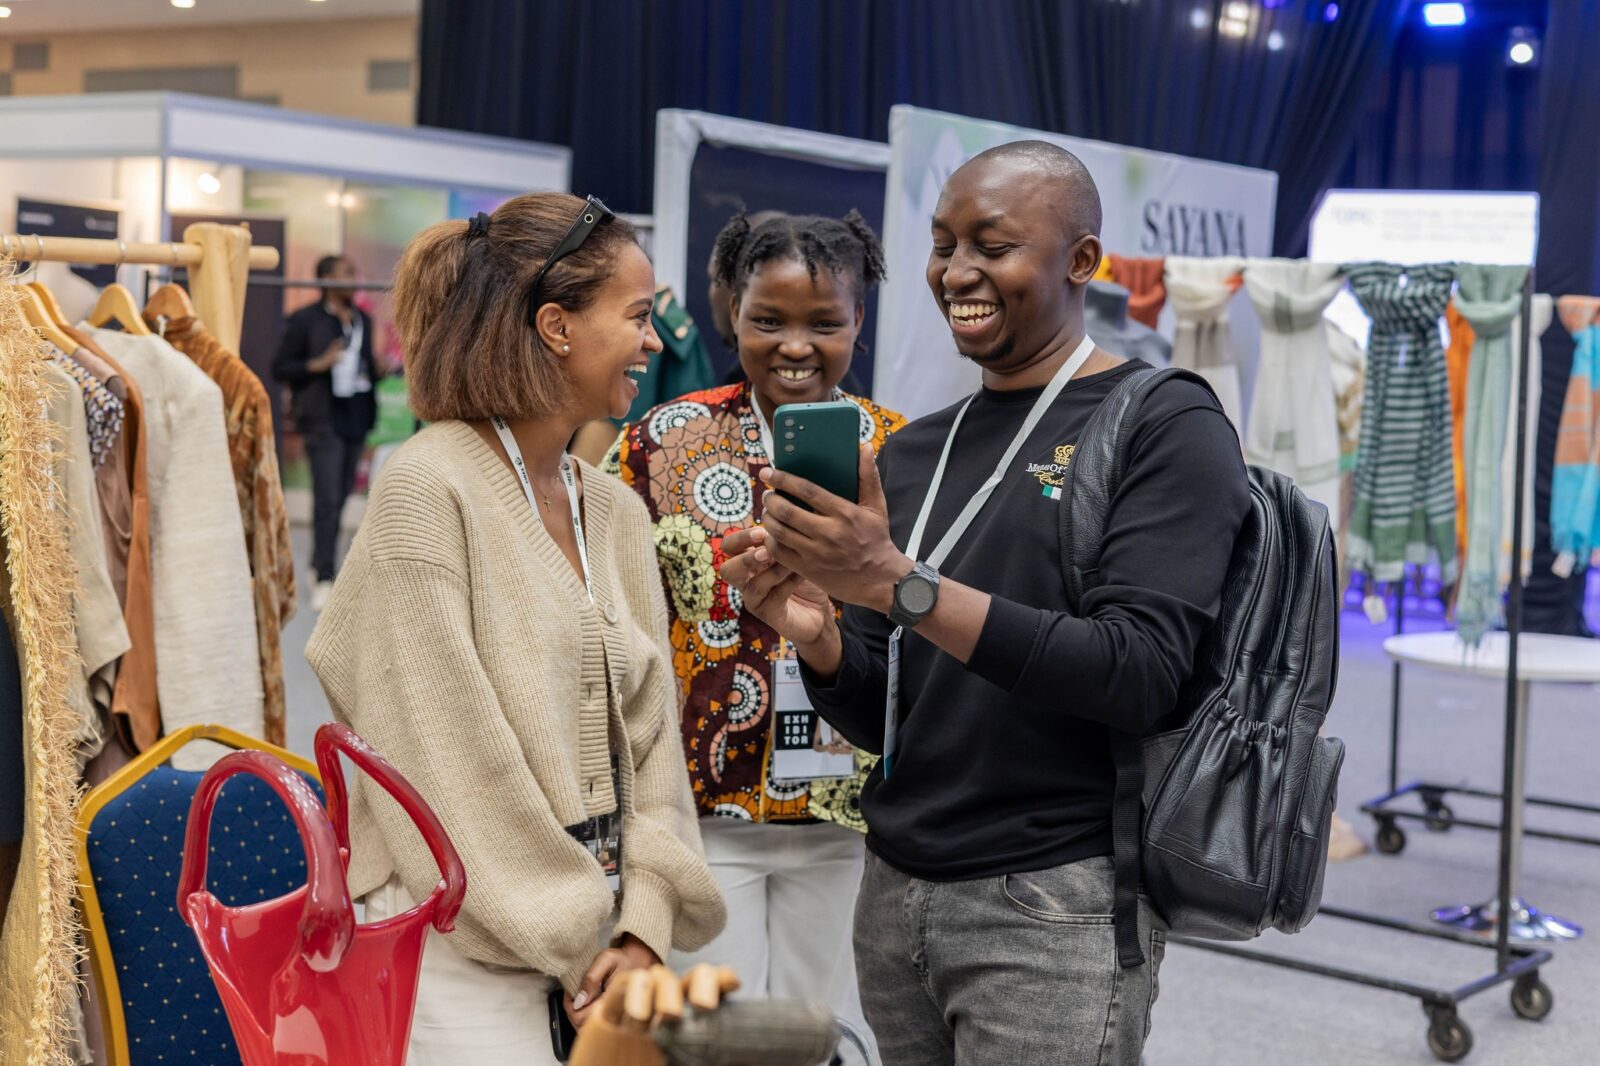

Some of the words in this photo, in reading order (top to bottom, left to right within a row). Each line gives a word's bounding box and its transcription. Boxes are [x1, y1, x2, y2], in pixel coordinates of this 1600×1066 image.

[1141, 199, 1248, 258] SAYANA
[784, 715, 809, 724] EXH
[785, 725, 808, 735] IBI
[784, 736, 809, 745] TOR
